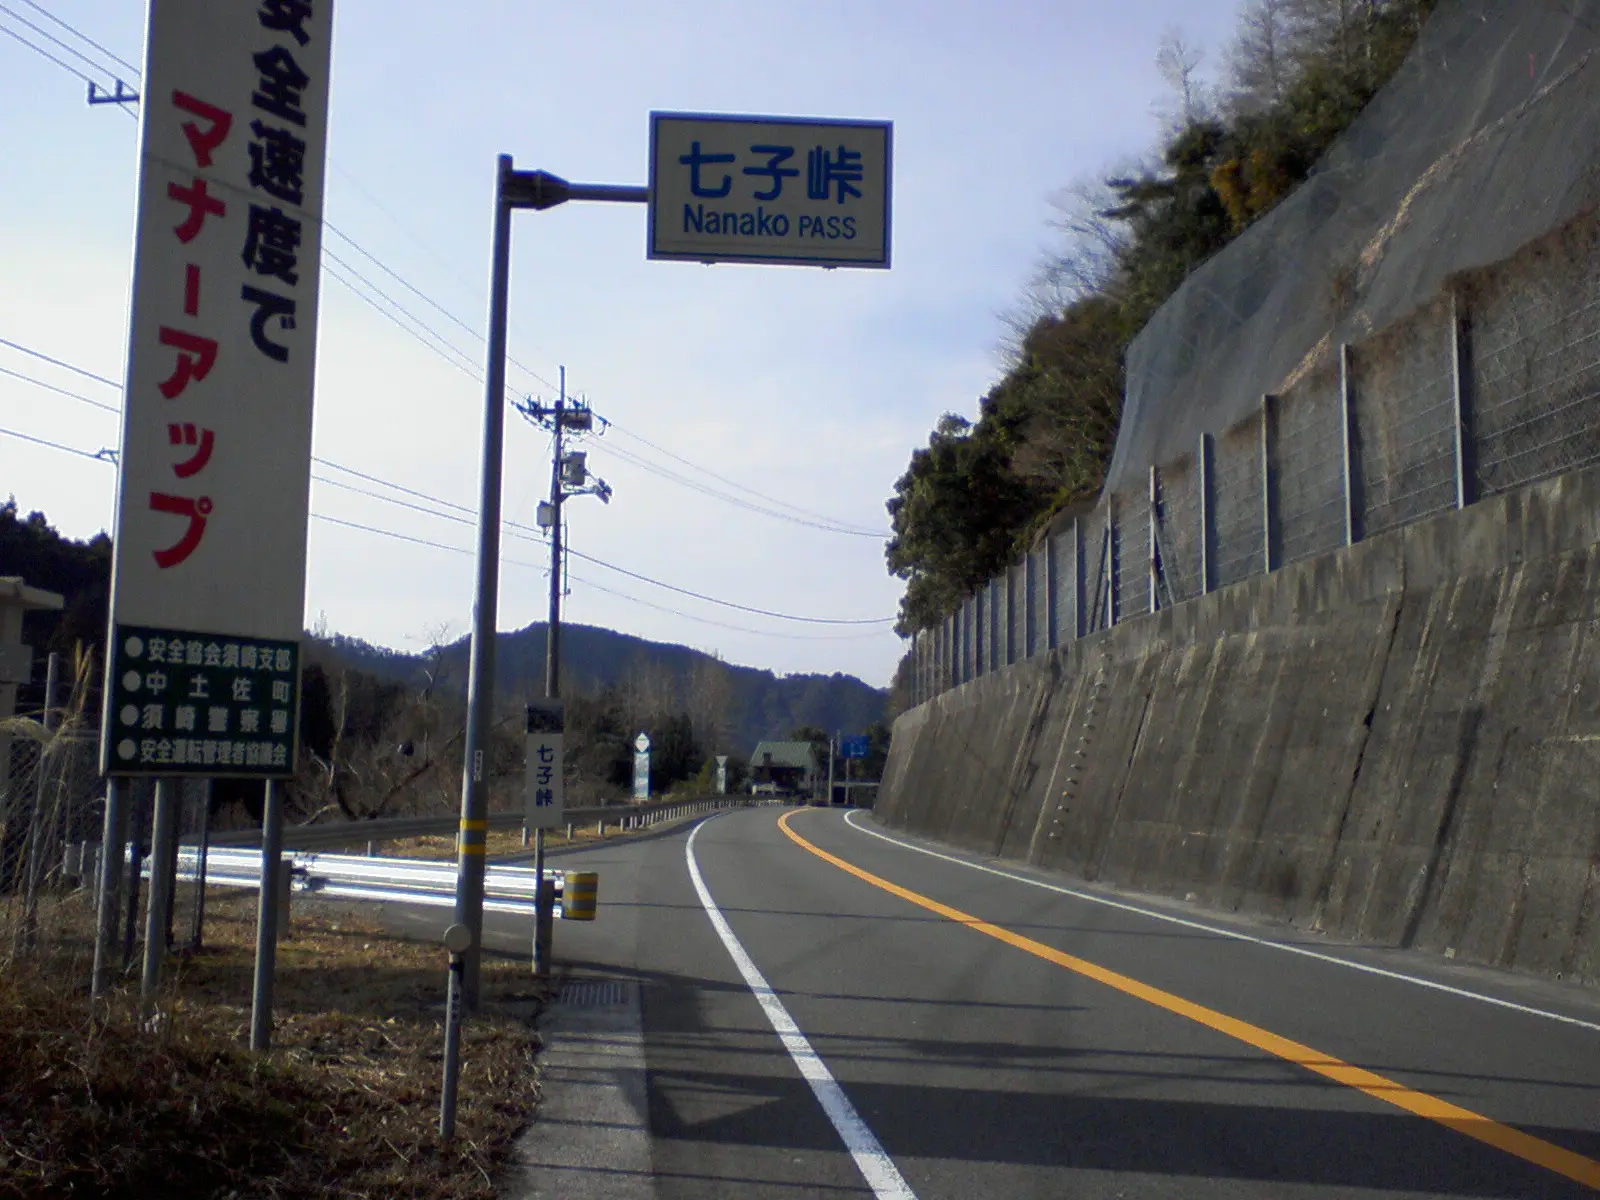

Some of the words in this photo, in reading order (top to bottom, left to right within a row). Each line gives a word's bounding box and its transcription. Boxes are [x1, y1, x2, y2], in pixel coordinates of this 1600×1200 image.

[678, 141, 864, 204] 七子峠
[683, 203, 789, 237] Nanako
[799, 215, 856, 240] PASS
[149, 88, 233, 569] マナーアップ
[536, 744, 554, 807] 七子峠
